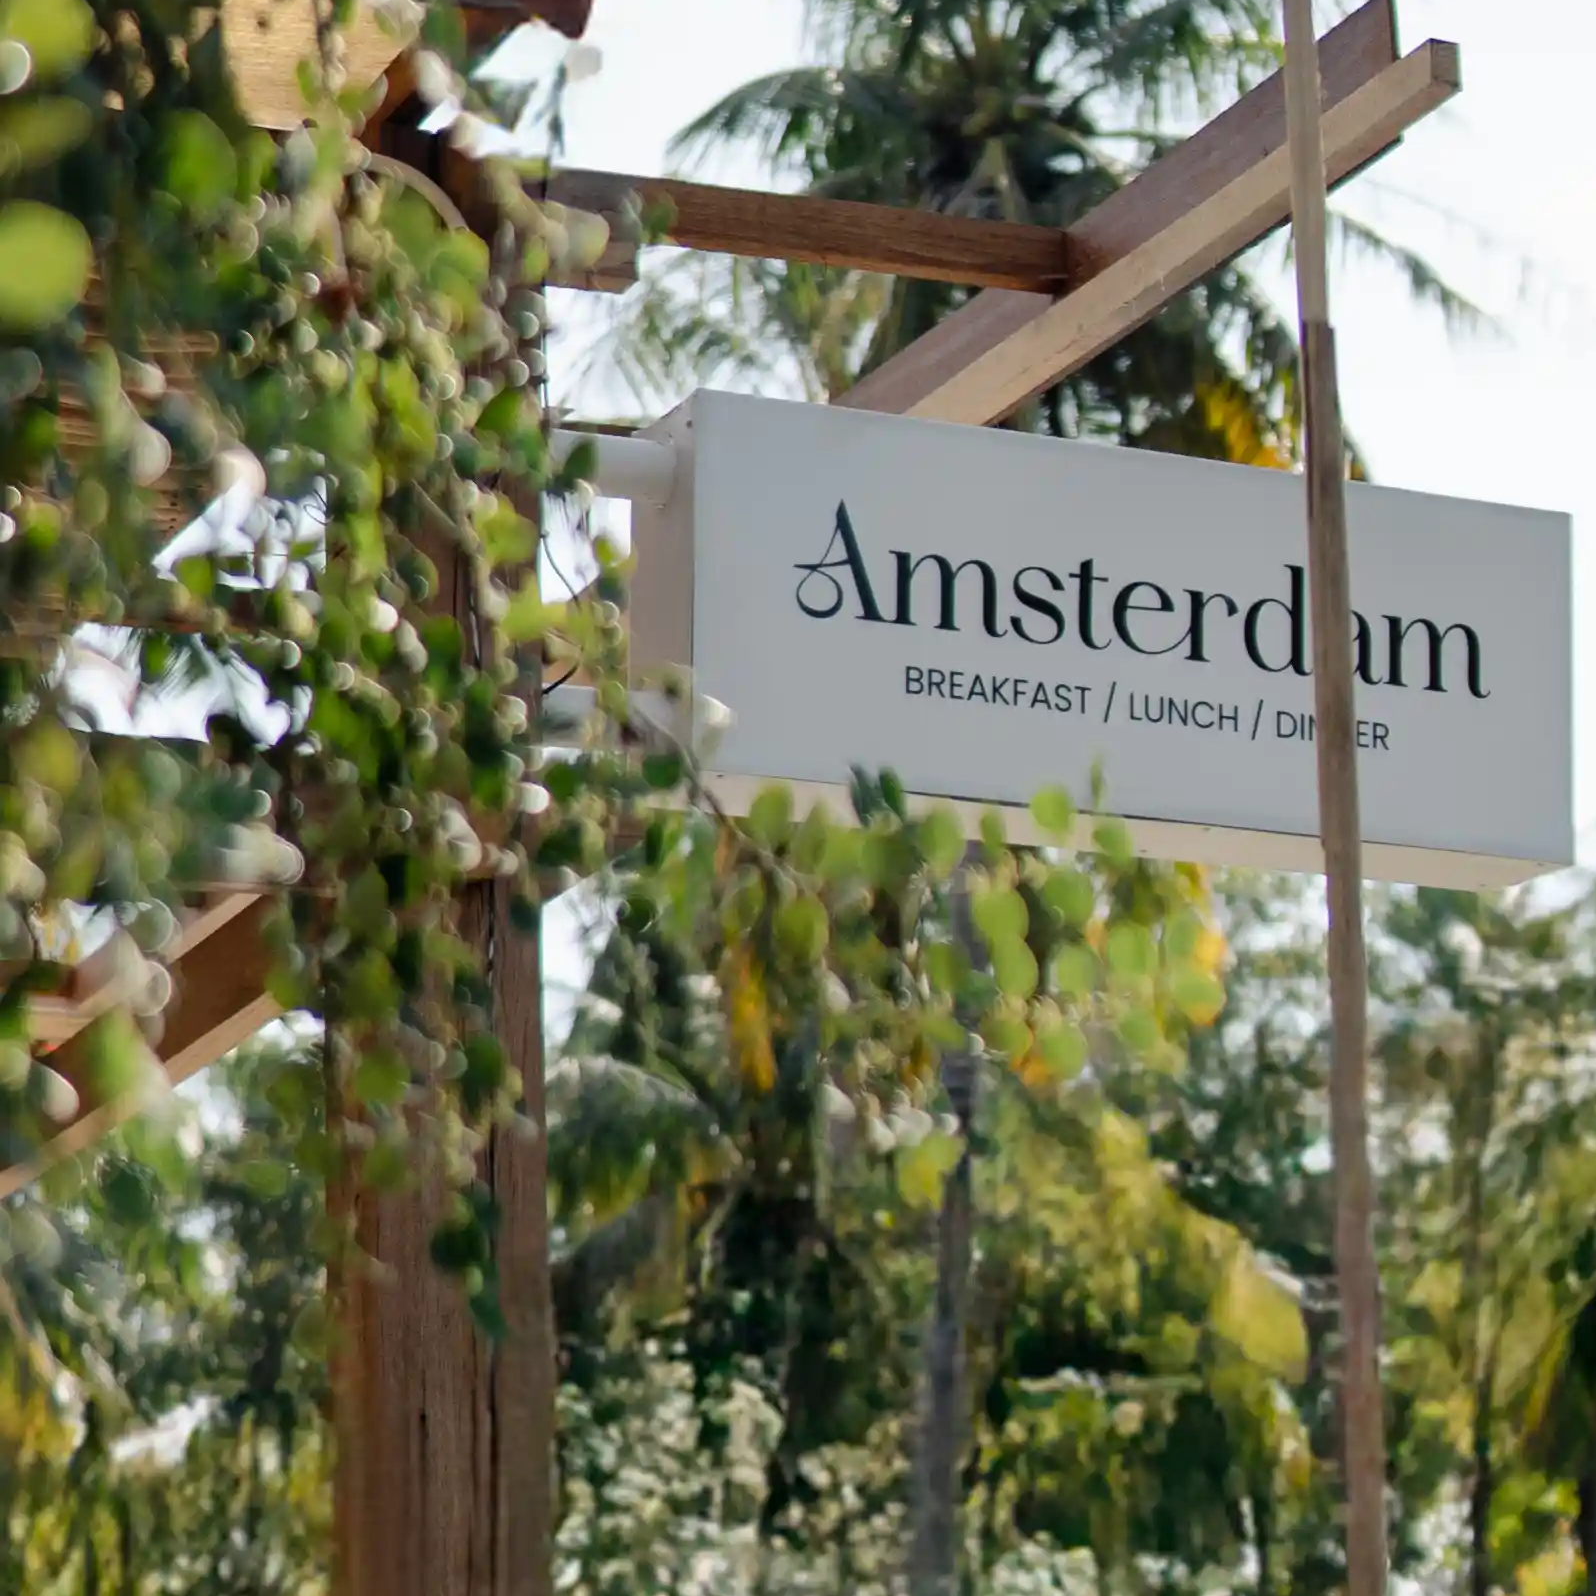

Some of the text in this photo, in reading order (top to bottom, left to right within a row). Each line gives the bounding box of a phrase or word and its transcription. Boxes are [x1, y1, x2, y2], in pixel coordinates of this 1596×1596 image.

[793, 498, 1491, 699] Amsterdam
[904, 665, 1391, 751] BREAKFAST / LUNCH / DIER
